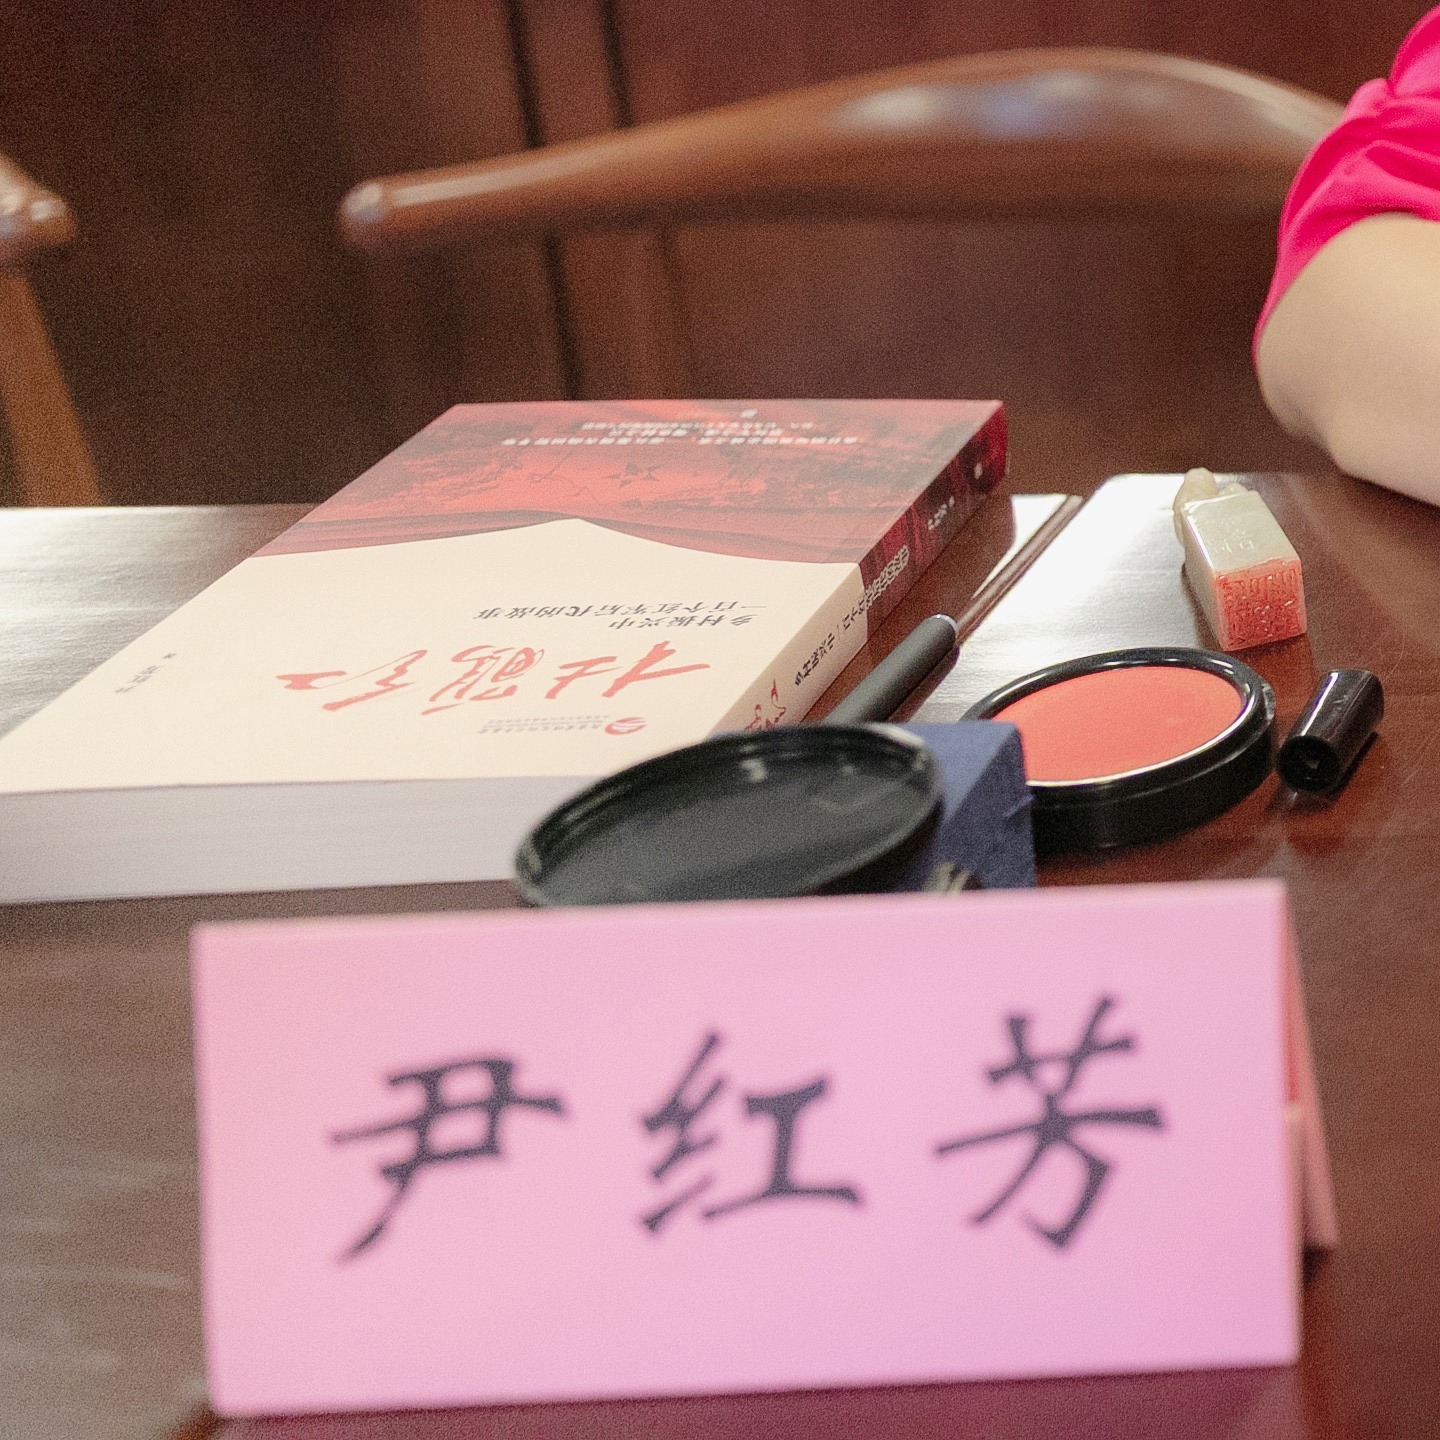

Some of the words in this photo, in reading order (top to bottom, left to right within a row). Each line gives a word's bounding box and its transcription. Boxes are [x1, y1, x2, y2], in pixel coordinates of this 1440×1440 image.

[472, 600, 768, 620] 一百个红军后代的故事
[608, 613, 757, 630] 乡村振兴中
[326, 993, 1168, 1265] 尹红芳
